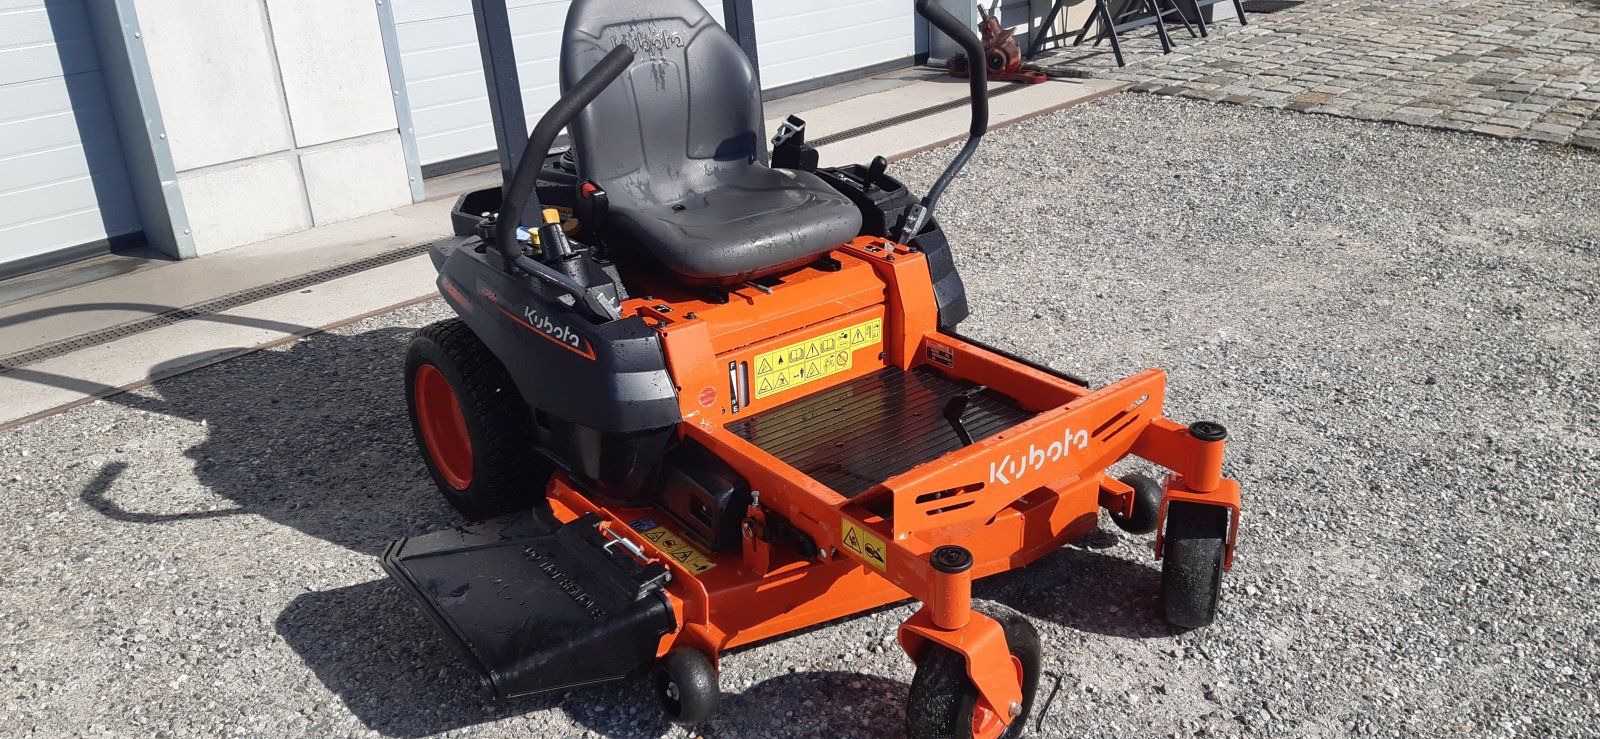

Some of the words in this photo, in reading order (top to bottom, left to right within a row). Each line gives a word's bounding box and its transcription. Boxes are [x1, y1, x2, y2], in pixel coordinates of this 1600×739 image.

[524, 305, 580, 348] Kubota
[730, 362, 736, 370] F
[989, 427, 1089, 485] Kubota
